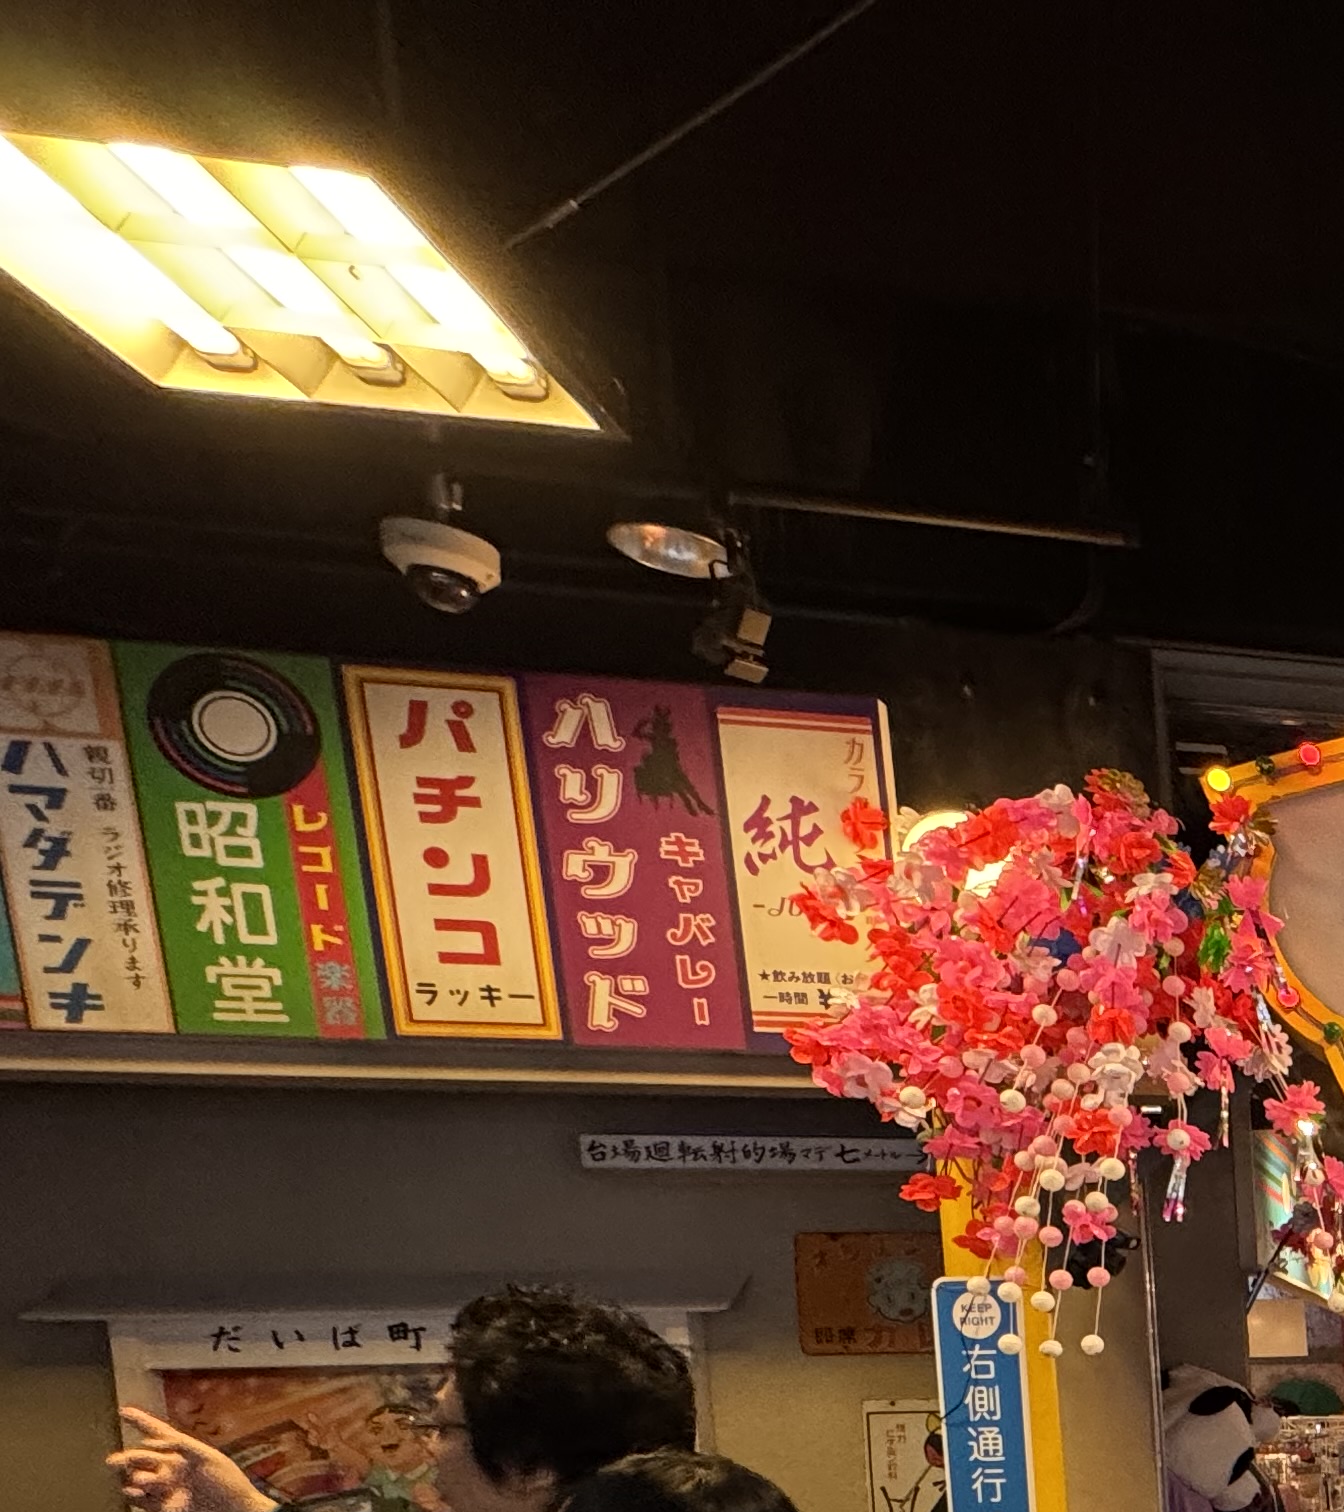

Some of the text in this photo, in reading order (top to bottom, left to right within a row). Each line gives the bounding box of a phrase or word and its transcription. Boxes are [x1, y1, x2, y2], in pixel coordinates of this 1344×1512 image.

[1, 740, 105, 1024] ハマダデンキ
[174, 800, 290, 1024] 昭和堂
[398, 699, 502, 967] パチンコ
[543, 693, 650, 1032] ハリウッド
[659, 832, 717, 1027] キャバレー
[414, 983, 536, 1008] ラッキー
[960, 1316, 996, 1328] RIGHT
[961, 1303, 993, 1314] KEEP
[961, 1343, 1007, 1504] 右側通行
